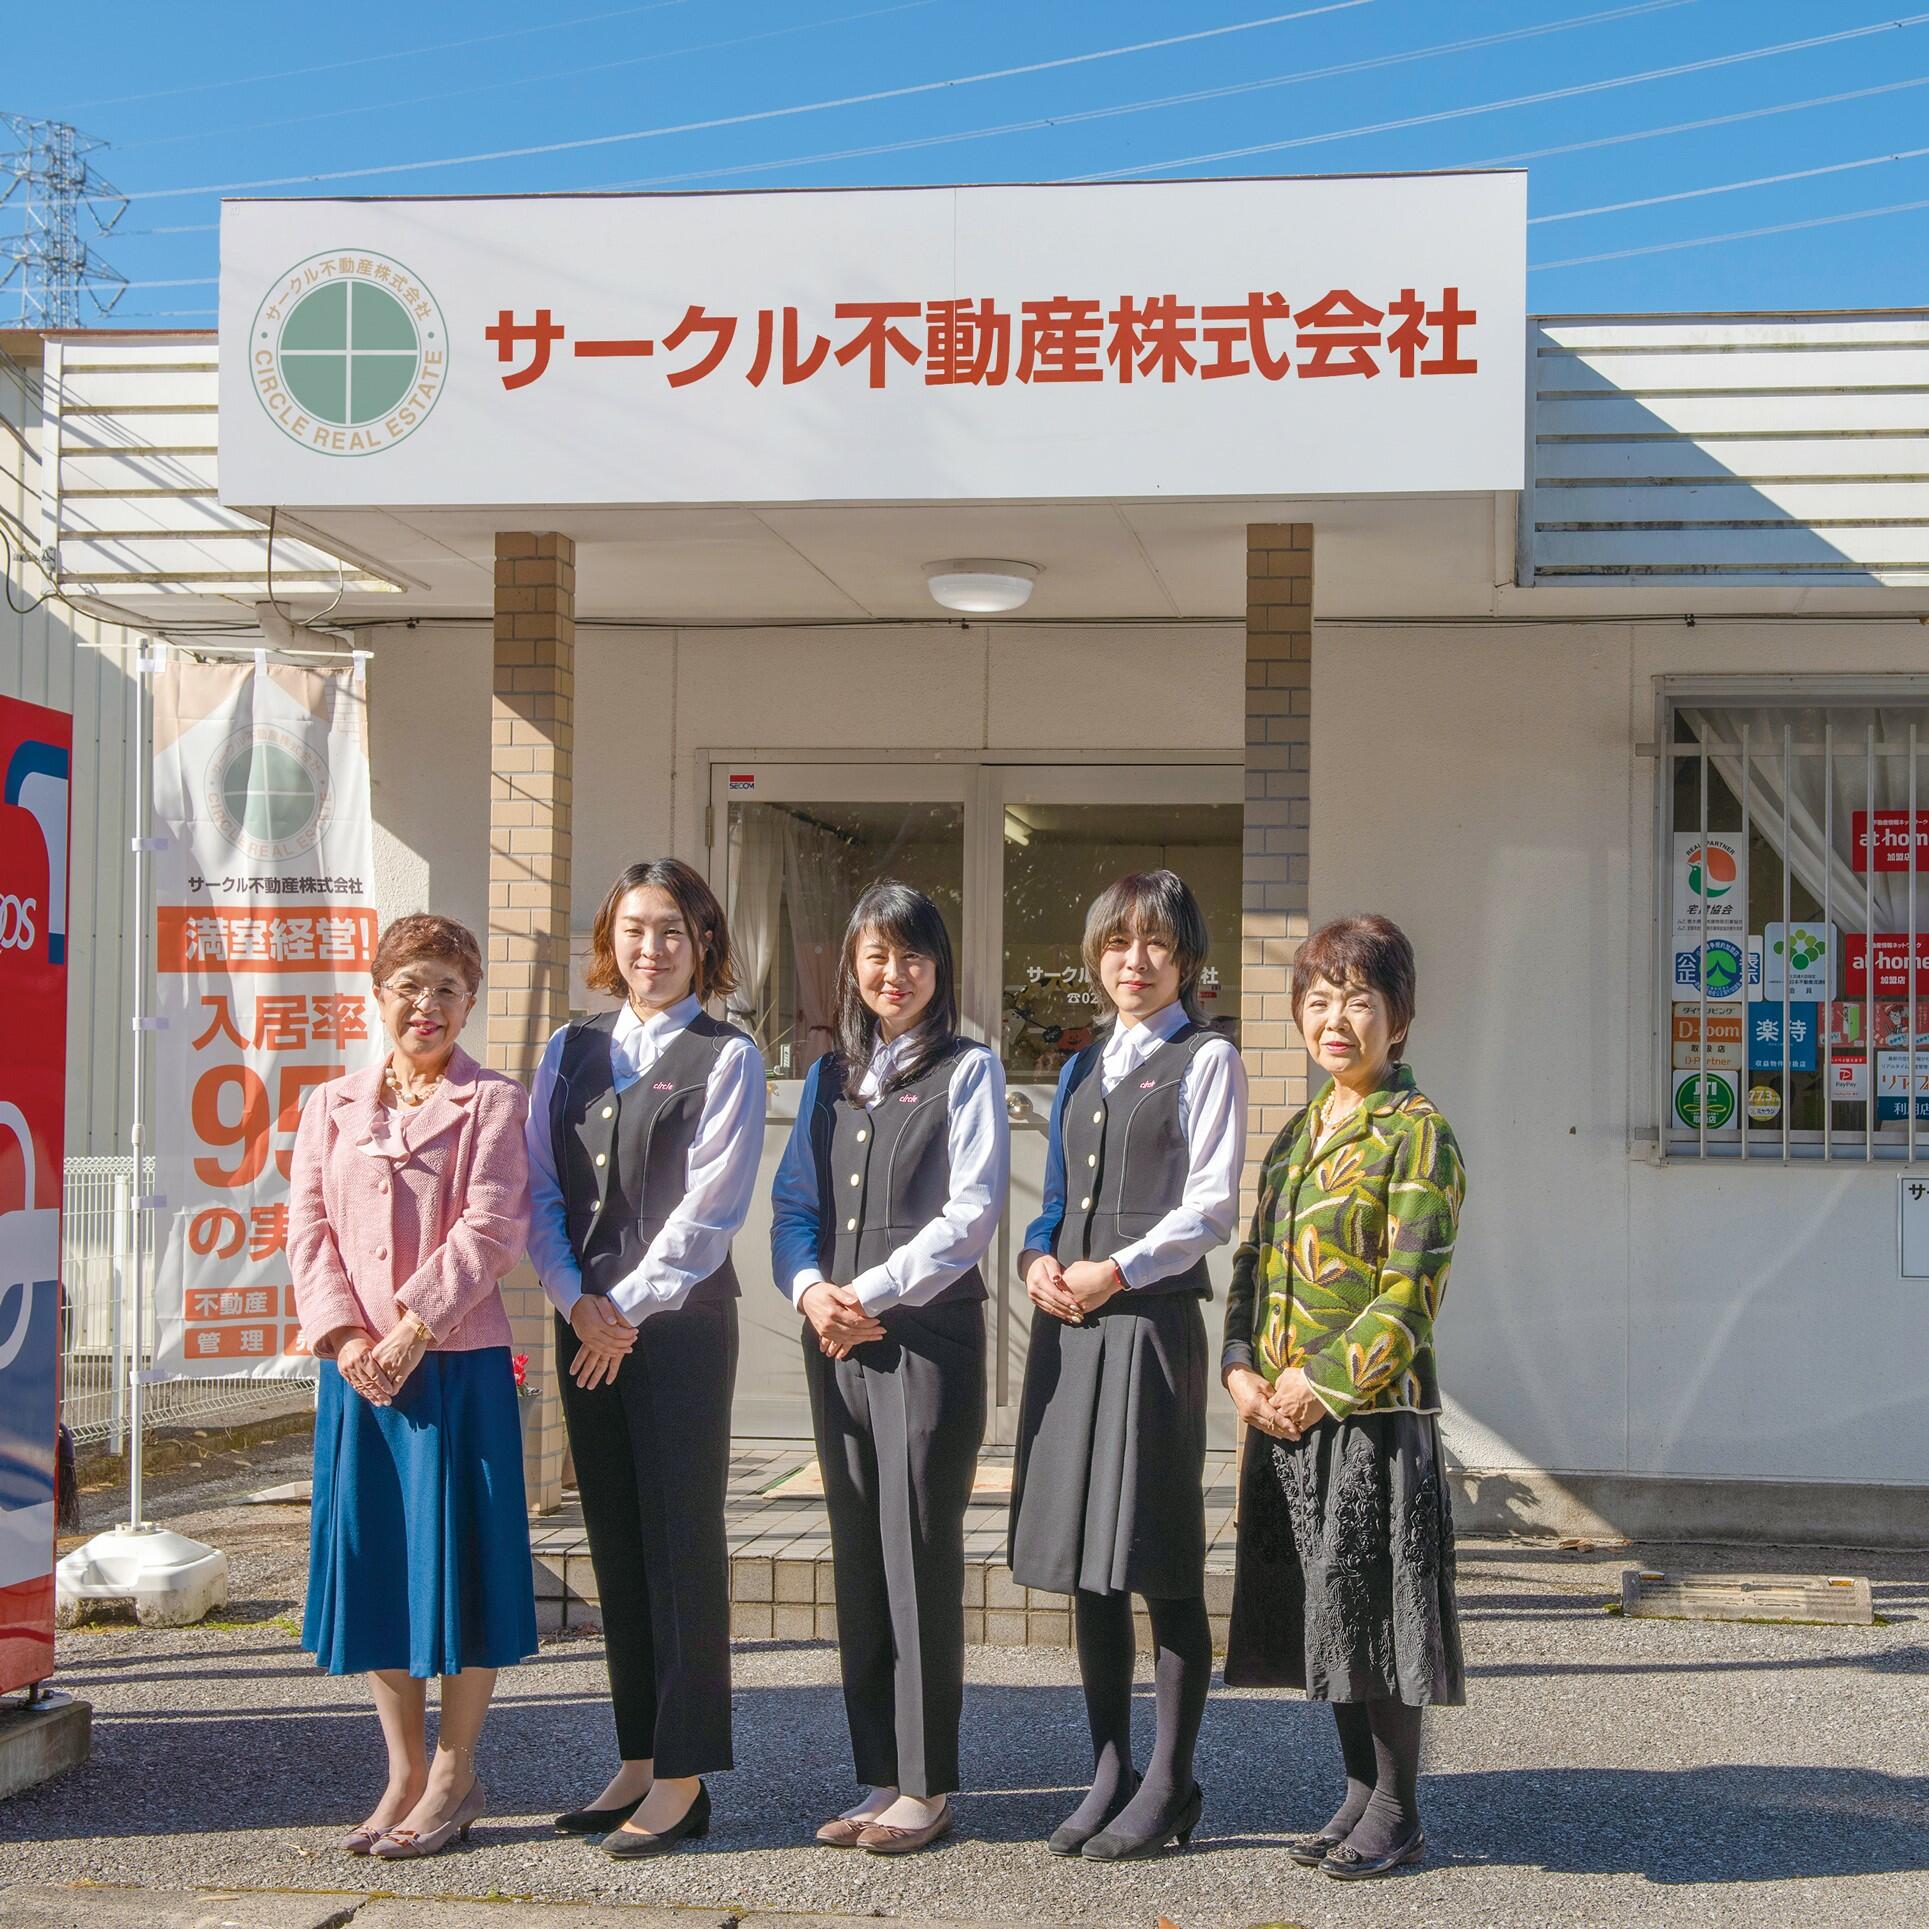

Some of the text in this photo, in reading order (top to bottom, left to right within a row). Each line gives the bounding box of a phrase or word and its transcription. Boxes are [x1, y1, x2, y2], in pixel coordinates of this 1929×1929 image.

[266, 257, 432, 321] サークル不動産株式会社
[484, 287, 1478, 391] サークル不動産株式会社
[255, 349, 442, 450] CIRCLE REAL ESTATE
[729, 782, 755, 790] SECOM
[188, 876, 364, 895] サークル不動産株式会社
[186, 917, 370, 961] 満室経営!
[1678, 954, 1696, 983] 公正
[192, 993, 368, 1050] 入居率
[1680, 1021, 1740, 1038] D-oom
[1685, 1056, 1731, 1065] D-Prtner
[1755, 1060, 1807, 1068] 収益物件扱店
[1908, 1184, 1929, 1200] サ
[194, 1292, 268, 1317] 不動産
[197, 1329, 264, 1354] 管理
